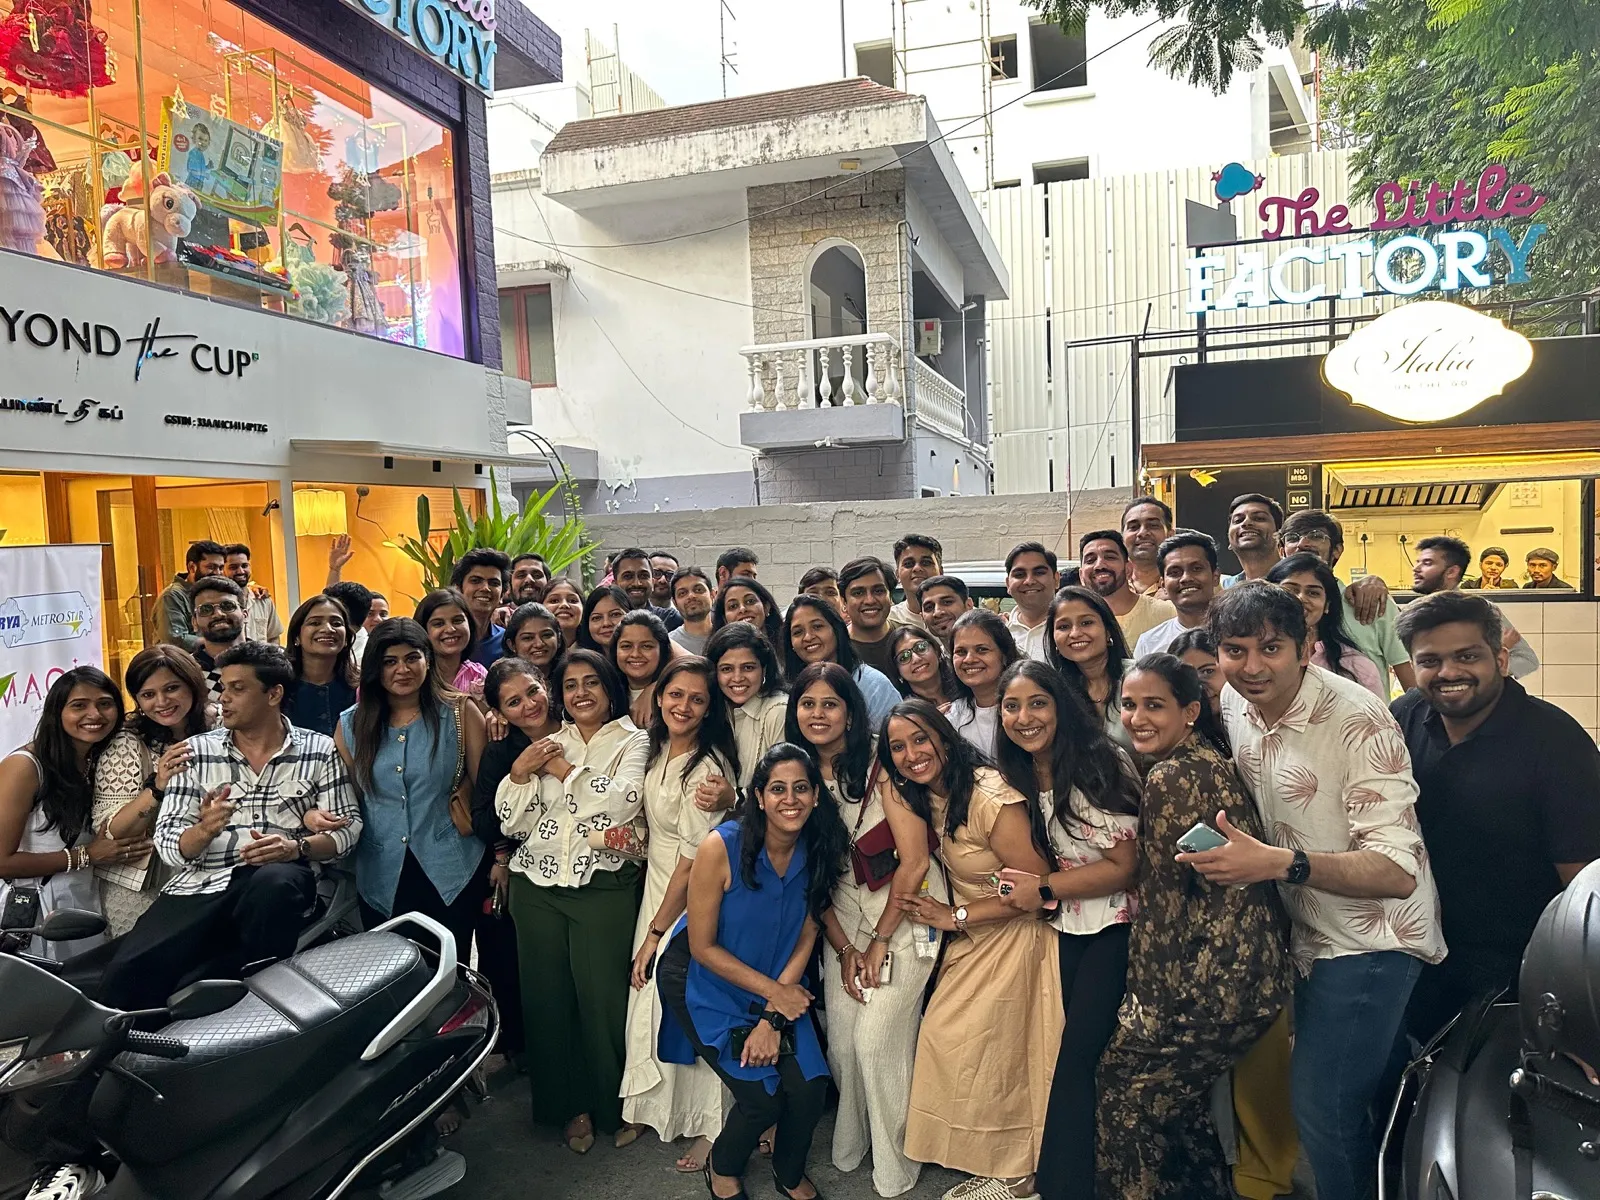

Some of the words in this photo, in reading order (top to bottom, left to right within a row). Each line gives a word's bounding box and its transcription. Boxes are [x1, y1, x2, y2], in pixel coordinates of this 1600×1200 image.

[1258, 187, 1352, 241] The
[1369, 164, 1546, 231] Little
[1185, 224, 1547, 314] FACTORY
[126, 317, 198, 382] the
[191, 343, 251, 378] CUP
[1291, 496, 1307, 504] NO
[31, 612, 65, 627] METRO
[66, 610, 84, 623] STAR
